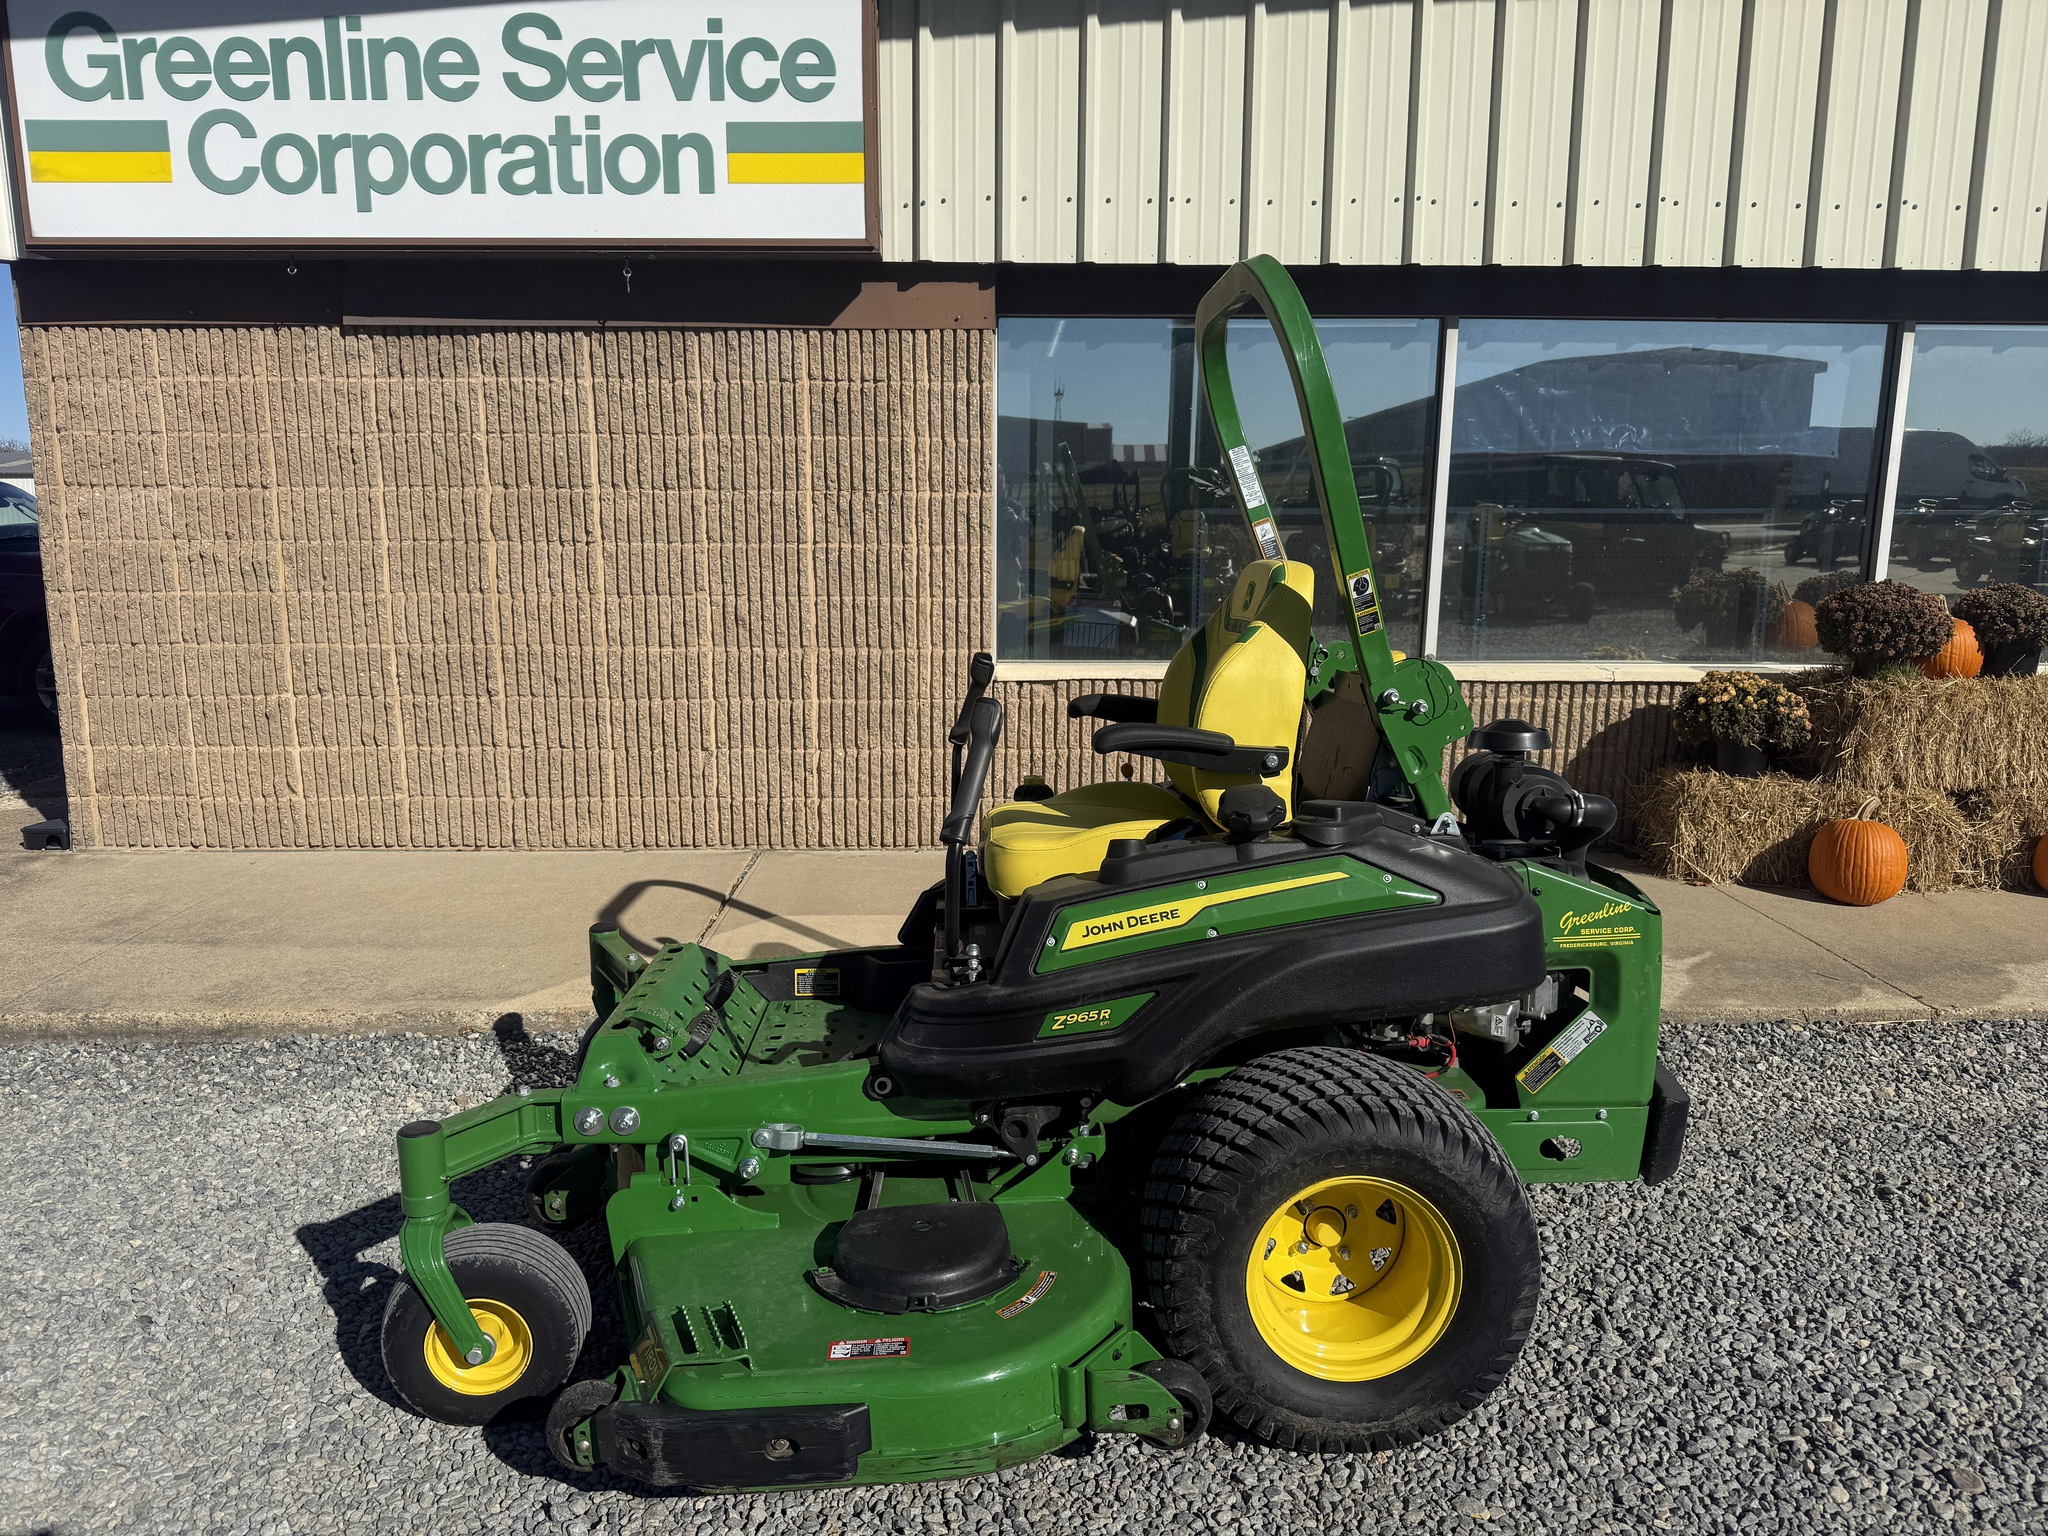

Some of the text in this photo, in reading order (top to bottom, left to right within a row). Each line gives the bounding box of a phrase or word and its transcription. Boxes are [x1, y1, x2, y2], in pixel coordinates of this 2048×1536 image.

[45, 11, 836, 102] Greenline Service
[187, 108, 715, 212] Corporation
[1082, 908, 1181, 938] JOHN DEERE
[1559, 901, 1632, 935] Greenline
[1580, 926, 1636, 935] SERVICE CORP.
[1051, 1008, 1111, 1030] Z965R
